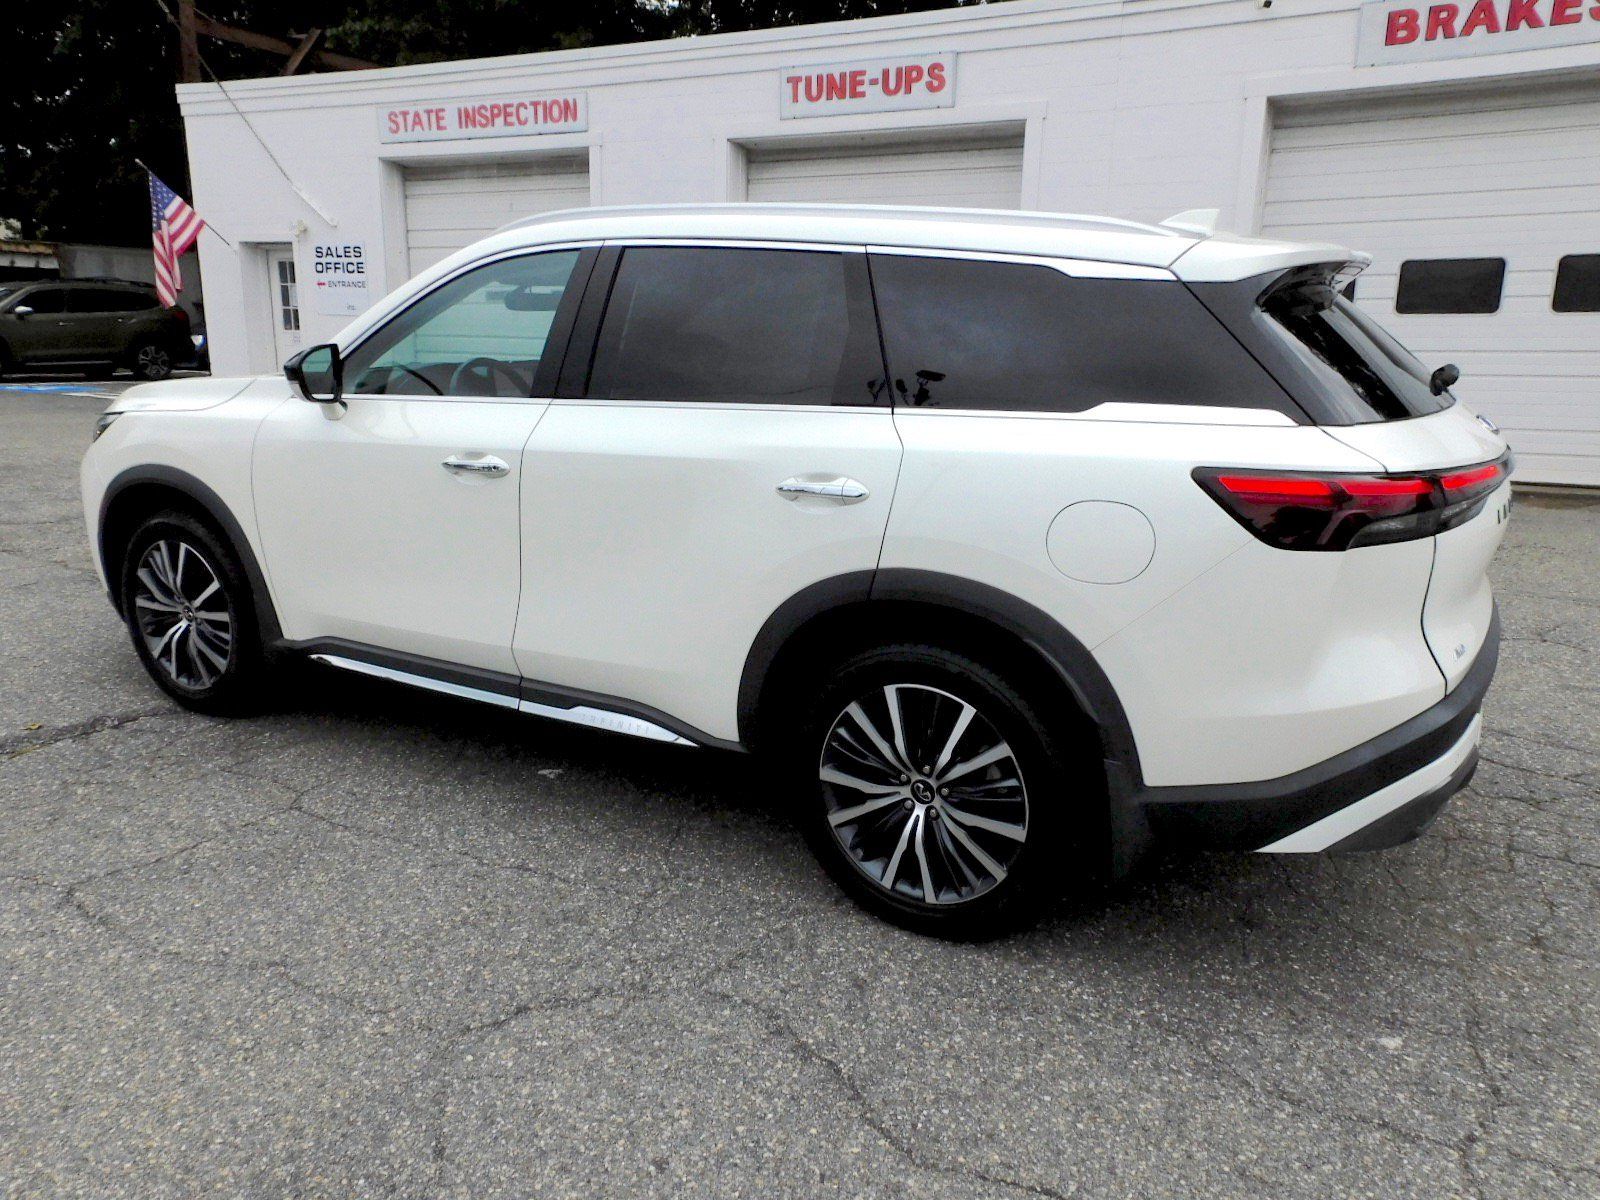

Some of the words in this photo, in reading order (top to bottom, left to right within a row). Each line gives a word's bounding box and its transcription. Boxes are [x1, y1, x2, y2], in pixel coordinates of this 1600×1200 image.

[787, 62, 946, 103] TUNE-UPS
[388, 108, 447, 134] STATE
[457, 98, 578, 129] INSPECTION
[315, 246, 362, 258] SALES
[315, 262, 365, 274] OFFICE
